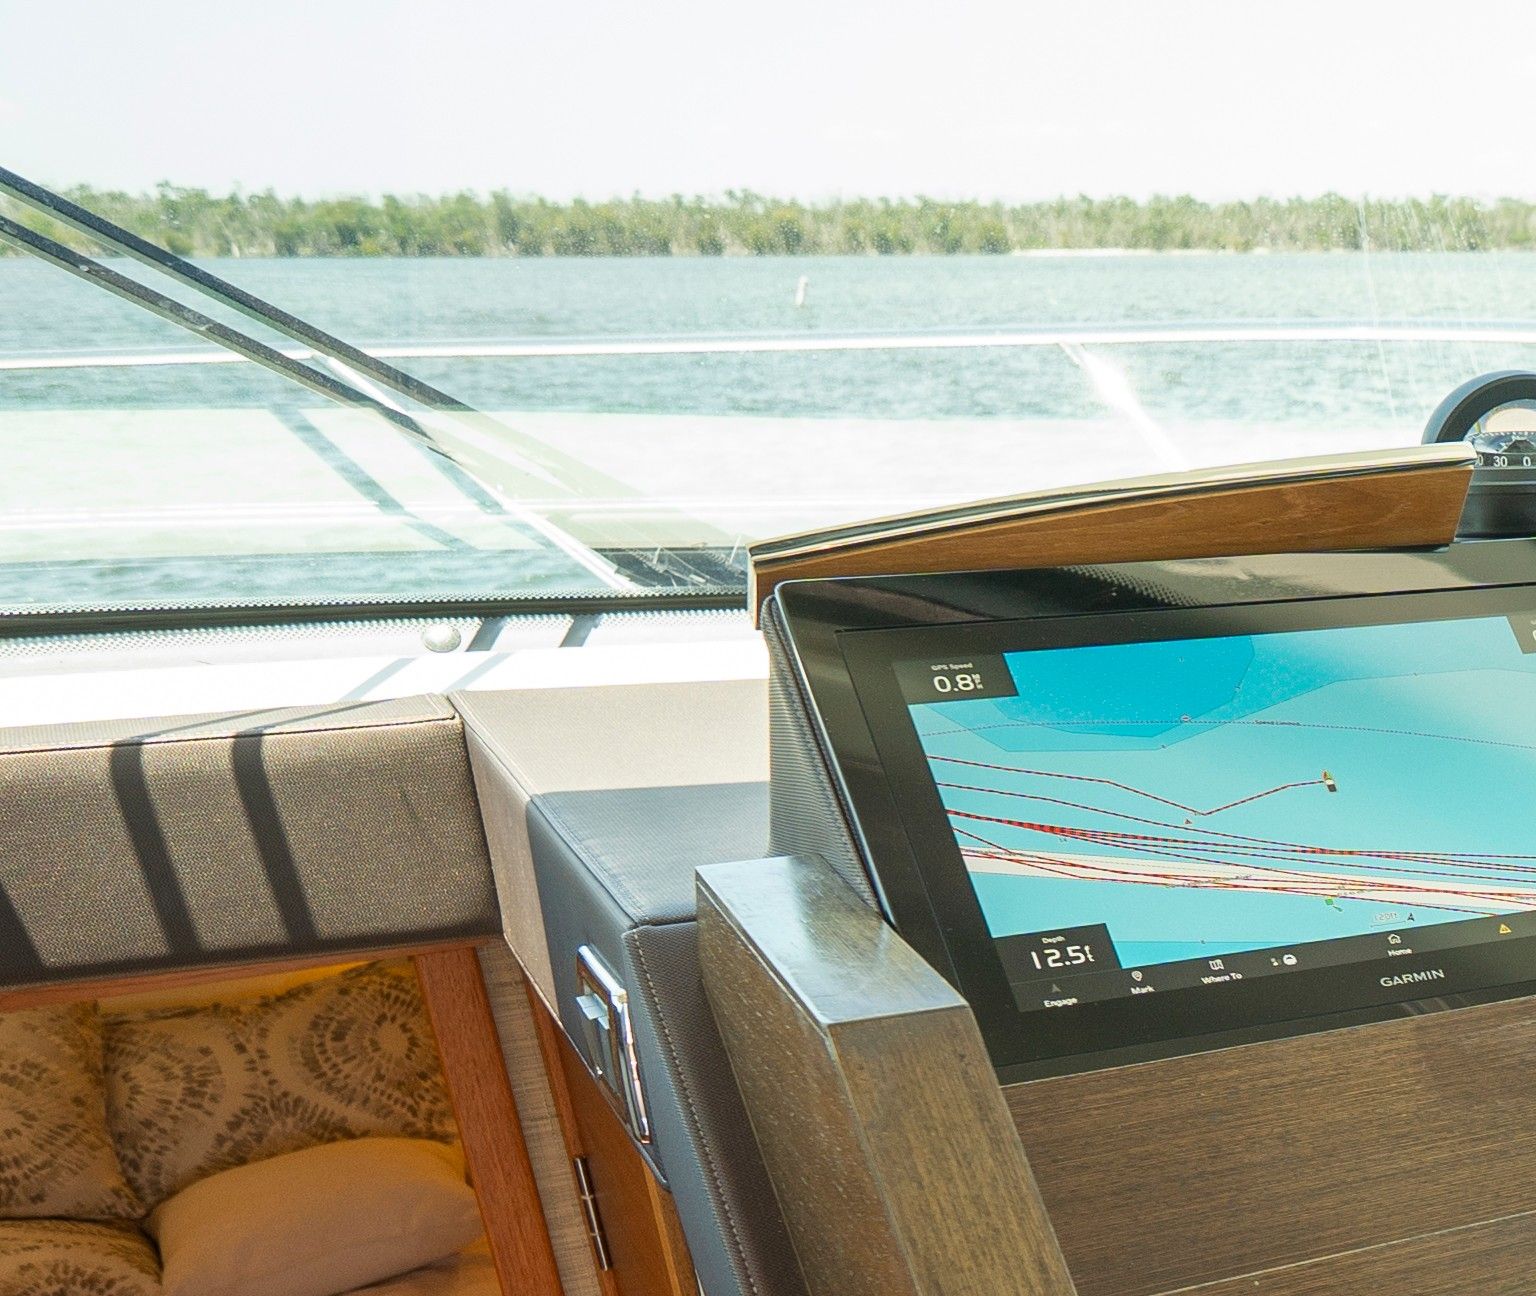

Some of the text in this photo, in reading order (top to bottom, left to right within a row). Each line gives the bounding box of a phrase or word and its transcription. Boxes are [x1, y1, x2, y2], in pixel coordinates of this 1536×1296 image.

[1493, 456, 1508, 467] 30
[1523, 456, 1531, 467] 0
[933, 674, 975, 693] 0.8
[1041, 935, 1066, 944] Depth
[1030, 945, 1088, 970] 12.5
[1387, 947, 1413, 957] Home
[1201, 972, 1243, 985] Where To
[1379, 968, 1445, 987] GARMIN
[1130, 985, 1155, 995] Mark
[1043, 997, 1078, 1009] Engage
